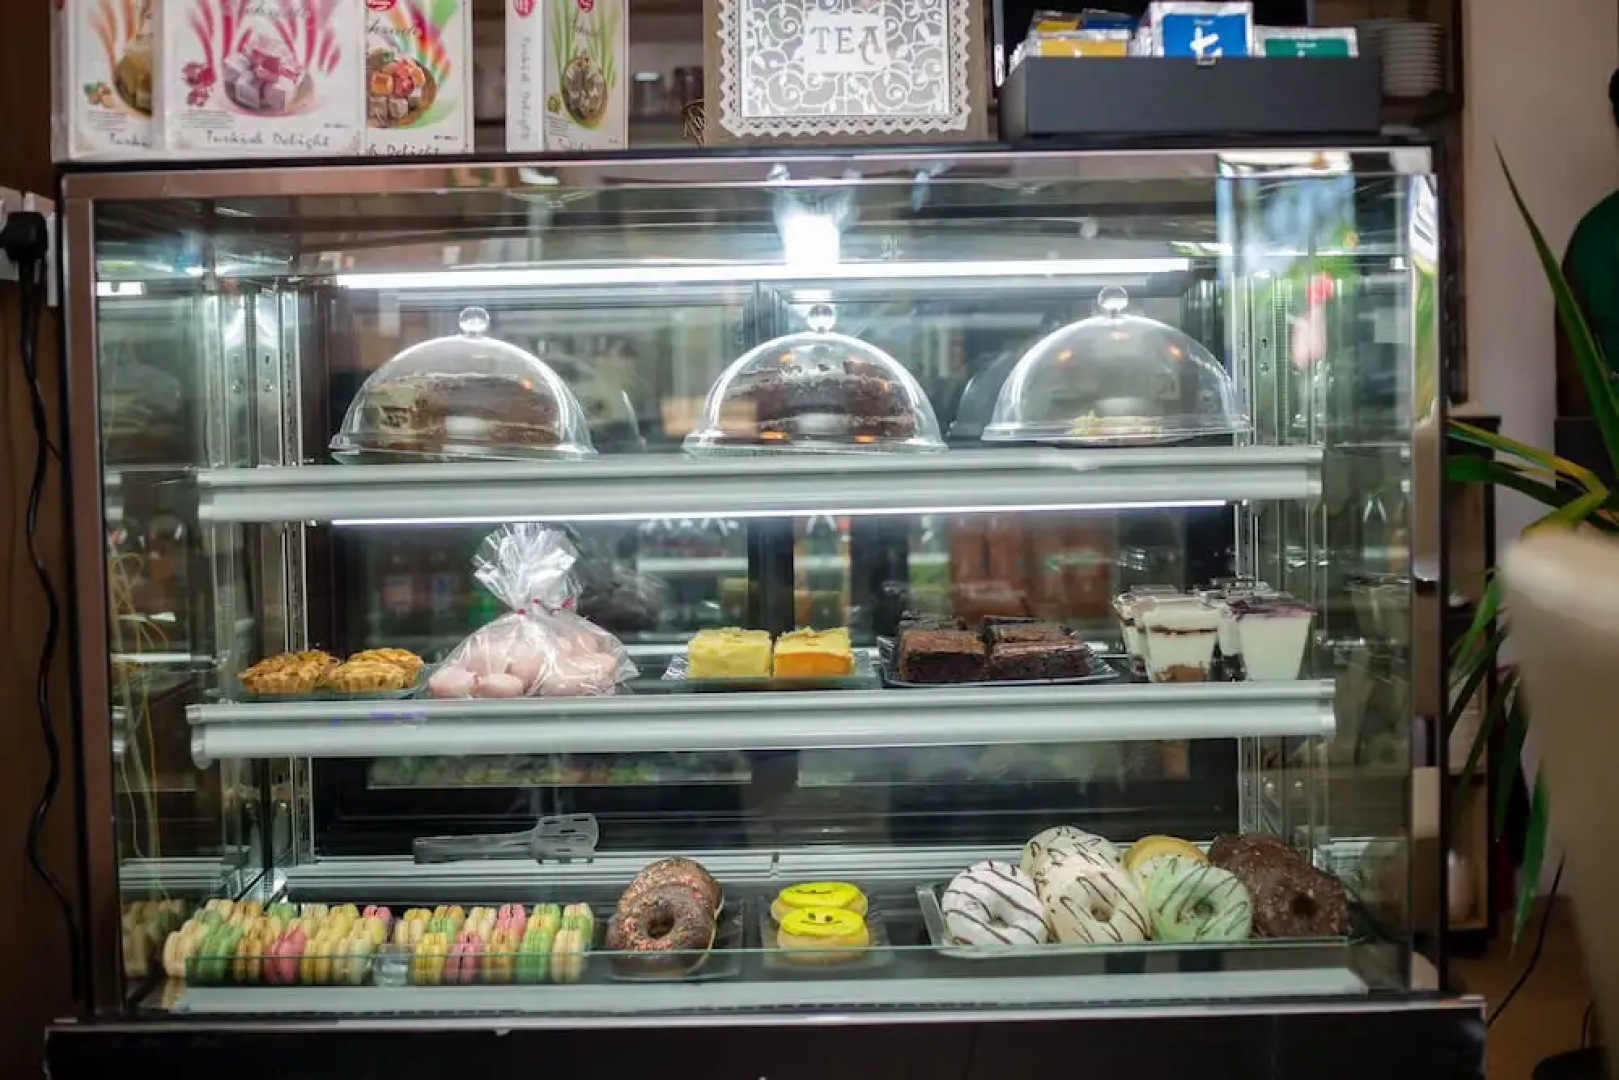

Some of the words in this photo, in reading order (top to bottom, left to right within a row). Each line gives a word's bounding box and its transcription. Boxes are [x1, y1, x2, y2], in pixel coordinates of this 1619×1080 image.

[809, 25, 885, 66] TEA
[206, 129, 264, 144] Turkish
[273, 131, 331, 150] Delight
